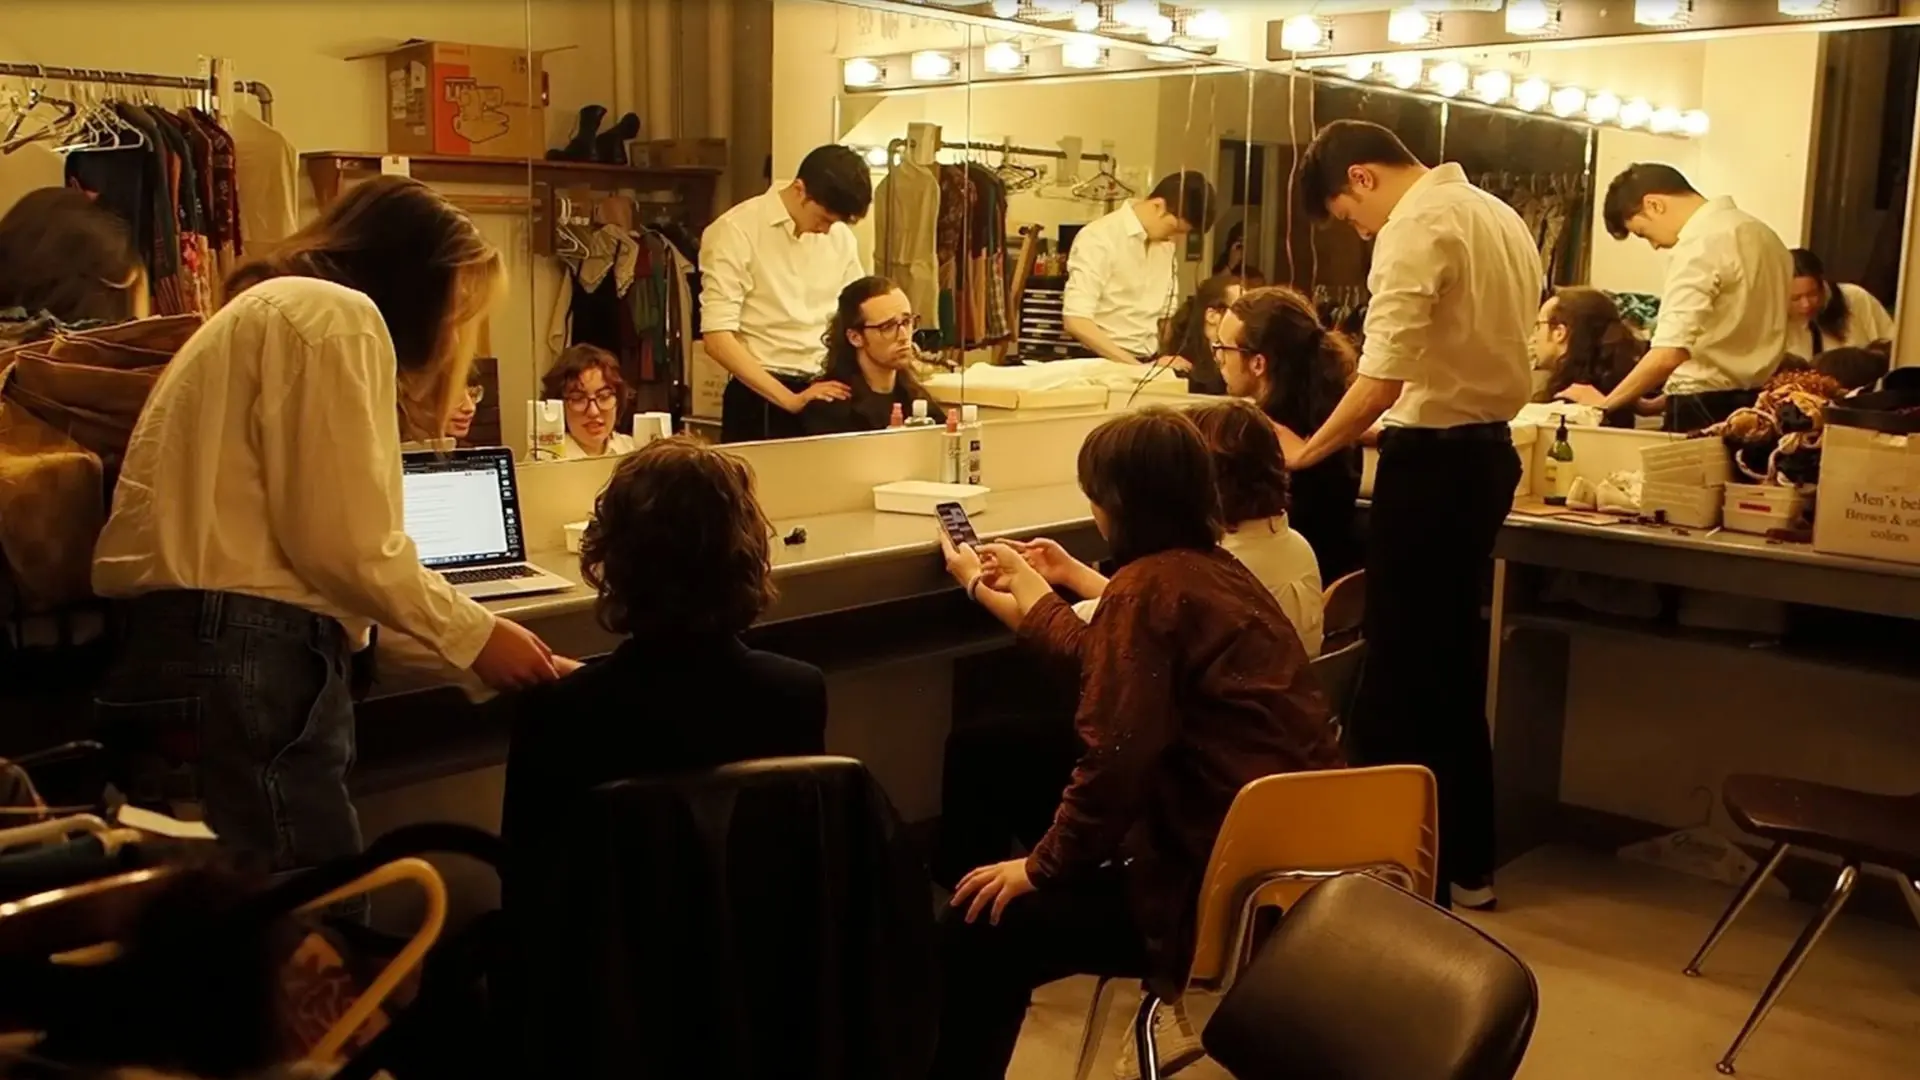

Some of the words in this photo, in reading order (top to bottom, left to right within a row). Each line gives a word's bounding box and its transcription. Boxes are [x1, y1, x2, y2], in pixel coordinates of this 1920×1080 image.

[1853, 491, 1897, 508] Men's
[1845, 508, 1888, 523] Brown
[1890, 513, 1901, 526] &
[1870, 529, 1910, 542] colors
